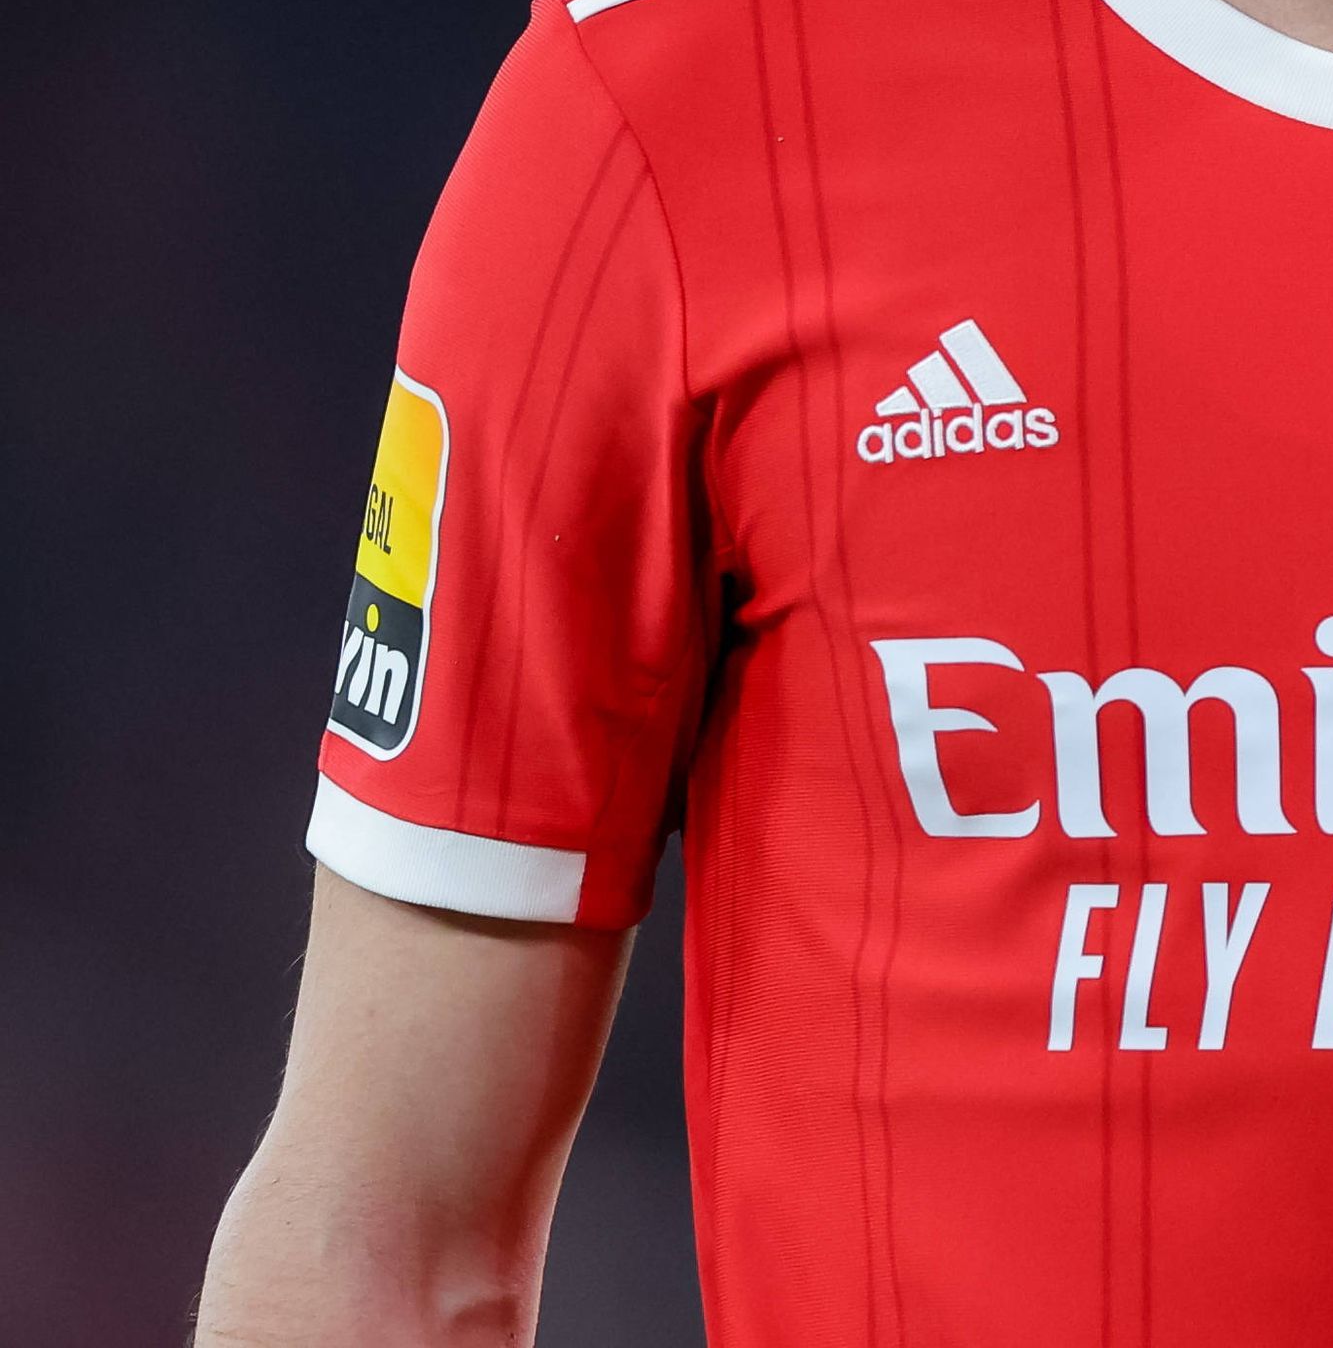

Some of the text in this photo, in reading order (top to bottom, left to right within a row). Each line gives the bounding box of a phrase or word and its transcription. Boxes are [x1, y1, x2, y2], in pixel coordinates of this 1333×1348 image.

[857, 402, 1060, 464] adidas
[362, 483, 394, 556] GAL
[1046, 881, 1272, 1052] FLY
